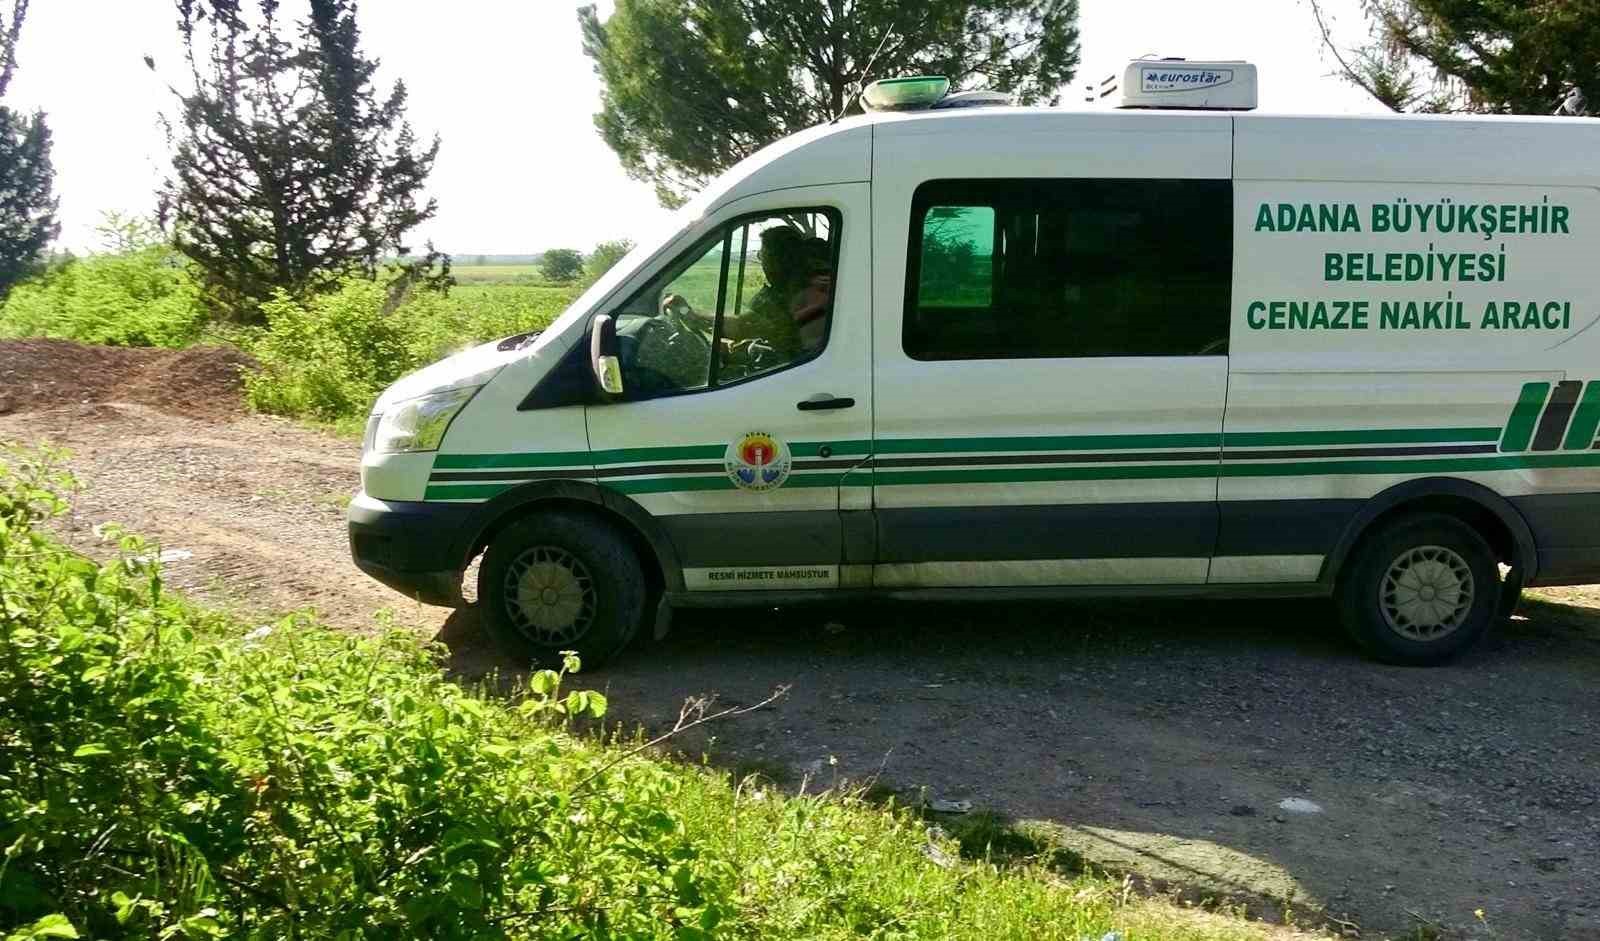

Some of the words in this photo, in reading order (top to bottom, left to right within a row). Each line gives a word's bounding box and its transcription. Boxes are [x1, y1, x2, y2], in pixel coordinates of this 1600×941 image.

[1254, 203, 1361, 233] ADANA
[1371, 195, 1570, 241] BÜYÜKŞEHİR
[1324, 243, 1506, 282] BELEDİYESİ
[1247, 301, 1370, 331] CENAZE
[1379, 291, 1472, 331] NAKİL
[1480, 301, 1571, 330] ARACI
